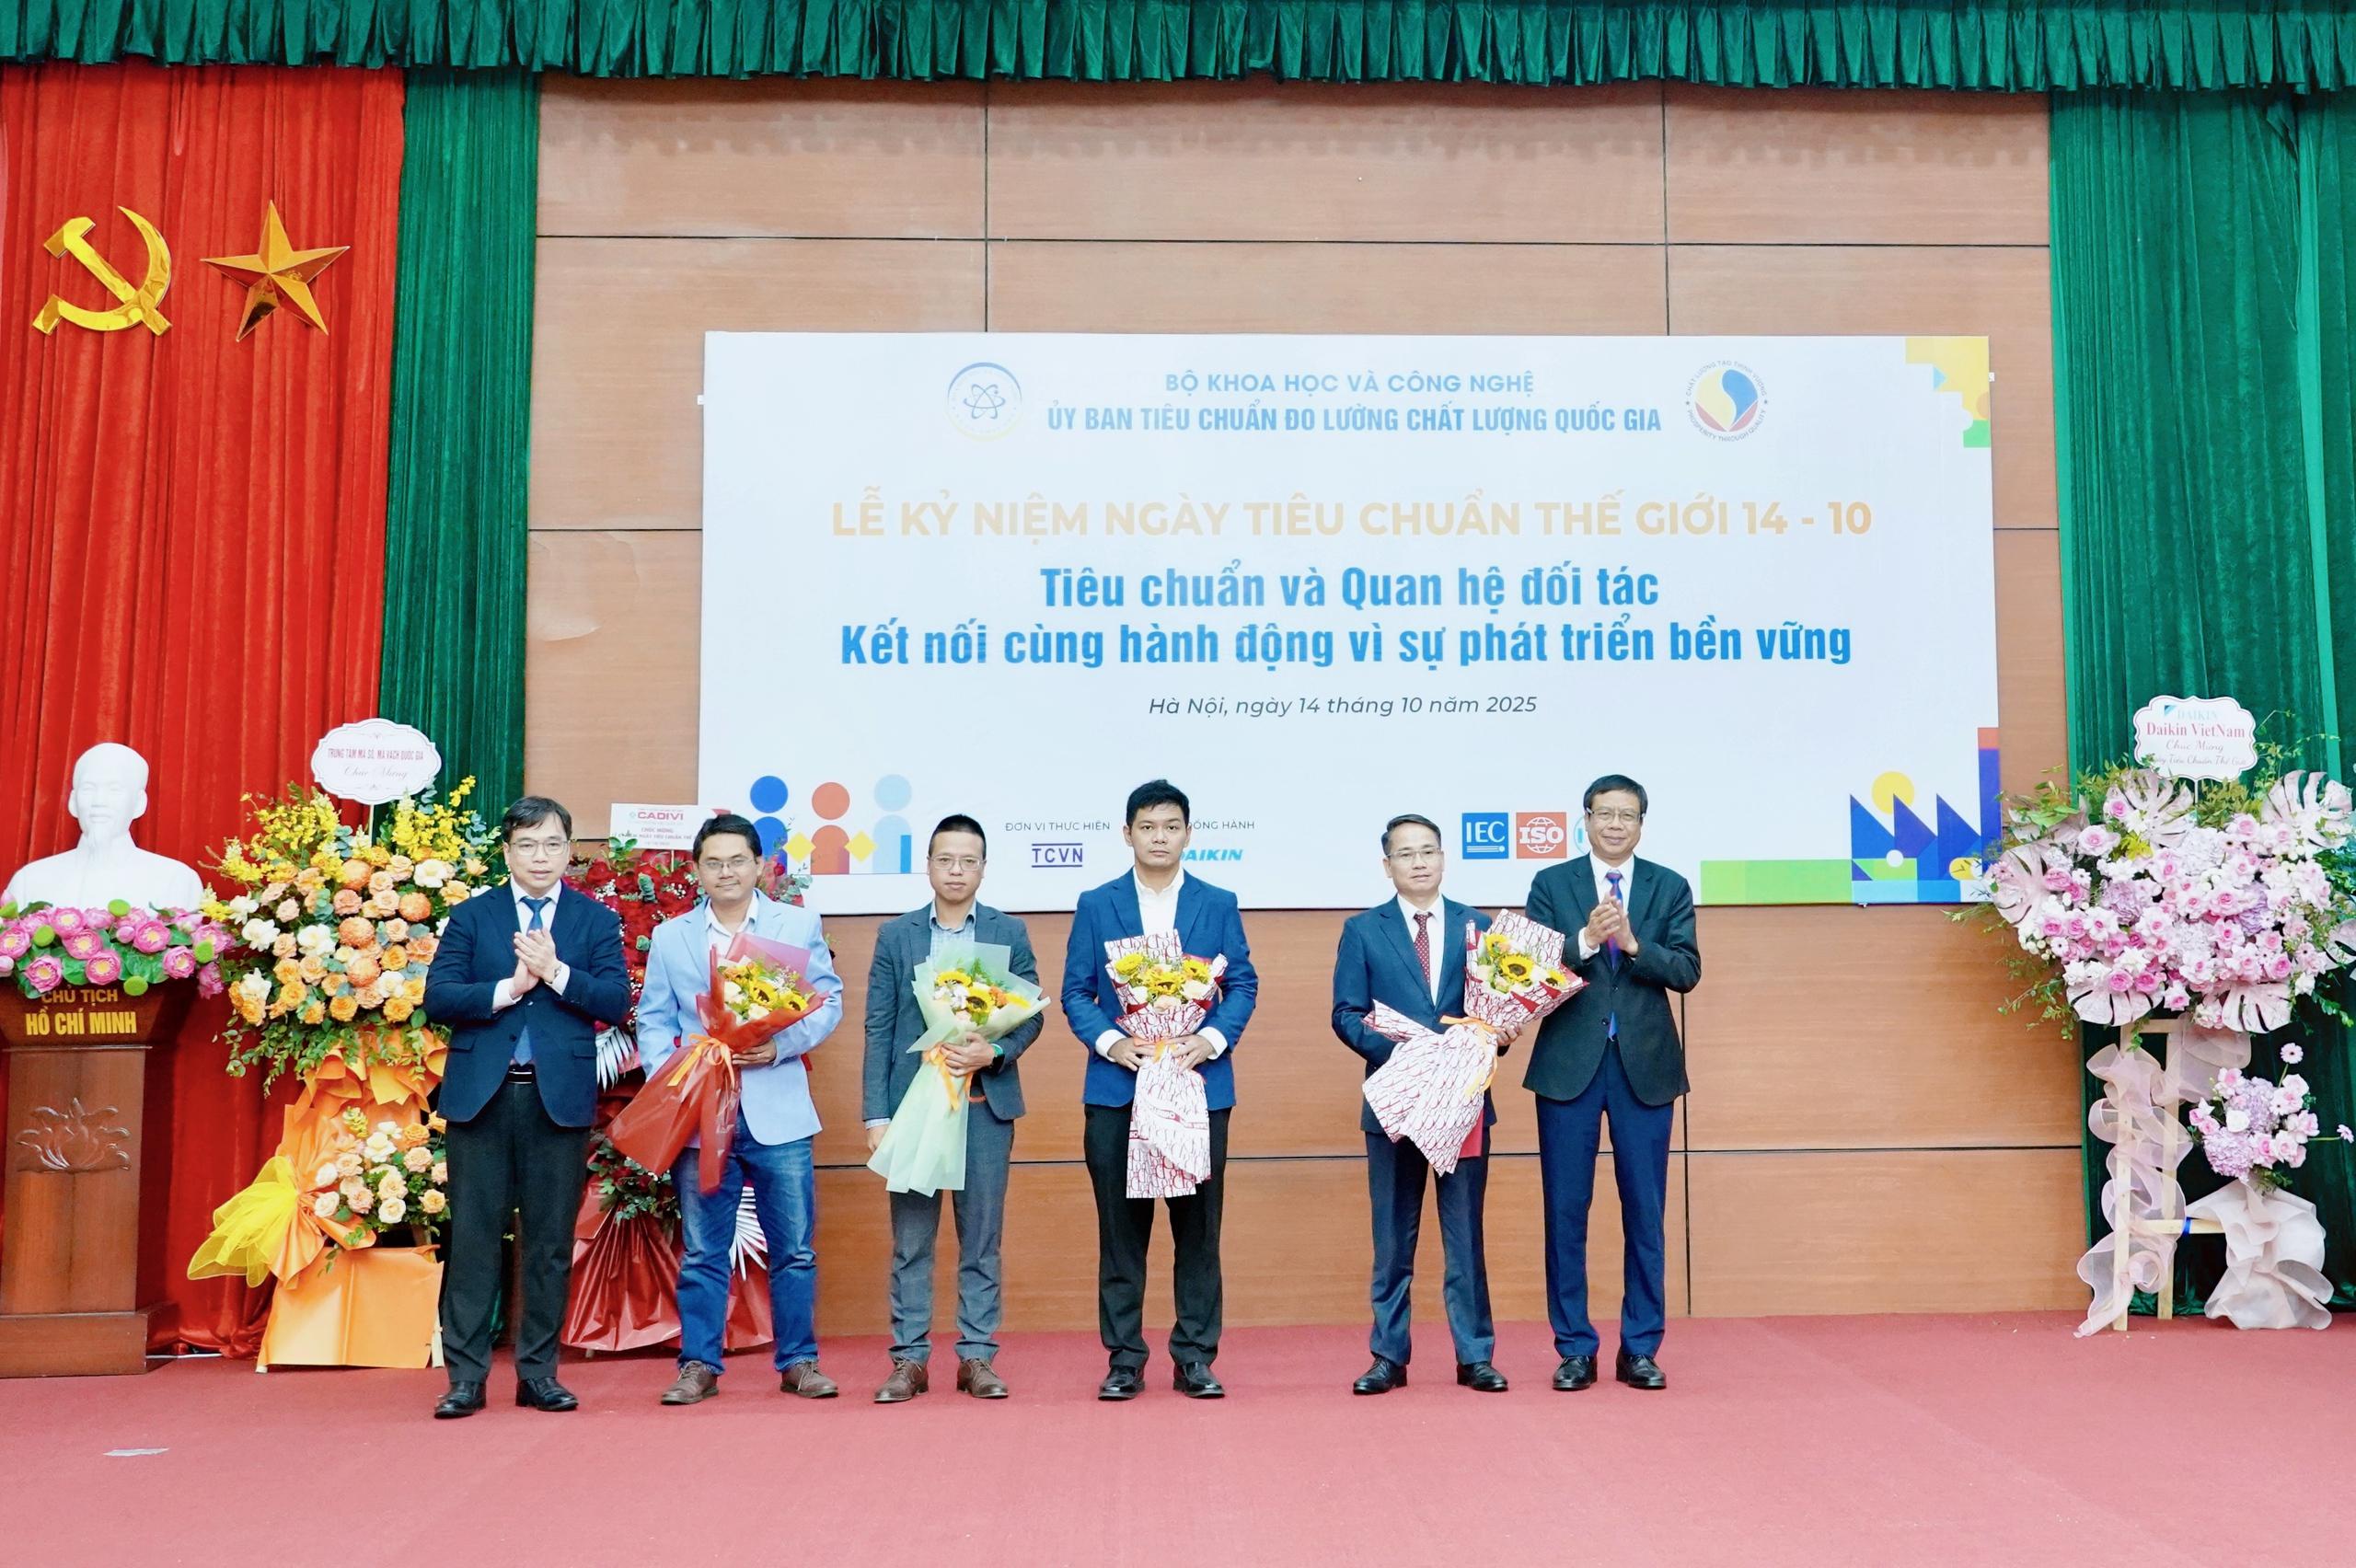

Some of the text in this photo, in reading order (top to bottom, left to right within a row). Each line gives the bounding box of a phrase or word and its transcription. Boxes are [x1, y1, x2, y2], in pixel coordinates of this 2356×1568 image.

[1165, 369, 1533, 398] BỘ KHOA HỌC VÀ CÔNG NGHỆ
[1046, 399, 1077, 431] ỦY
[1085, 408, 1133, 430] BAN
[1140, 403, 1190, 431] TIÊU
[1198, 398, 1277, 431] CHUẨN
[1284, 408, 1316, 431] ĐO
[1323, 403, 1399, 432] LƯỜNG
[1406, 400, 1465, 432] CHẤT
[1472, 406, 1548, 436] LƯỢNG
[1553, 401, 1616, 433] QUỐC
[1623, 408, 1662, 432] GIA
[833, 486, 1872, 545] LỄ KỶ NIỆM NGÀY TIÊU CHUẨN THẾ GIỚI 14 - 10
[1040, 559, 1659, 615] Tiêu chuẩn và Quan hệ đối tác
[841, 612, 1852, 672] Kết nối cùng hành động vì sự phát triển bền vững
[1149, 697, 1537, 718] Hà Nội, ngày 14 tháng 10 năm 2025
[2147, 722, 2245, 737] Daikin VietNam
[638, 812, 684, 821] CADIVI
[1005, 822, 1032, 832] ĐƠN
[1466, 821, 1507, 844] IEC
[1519, 826, 1565, 845] ISO
[1032, 847, 1083, 863] TCVN
[1181, 848, 1243, 861] AIKIN
[41, 985, 119, 1006] CHỦ TỊCH
[25, 1006, 137, 1035] HỒ CHÍ MINH
